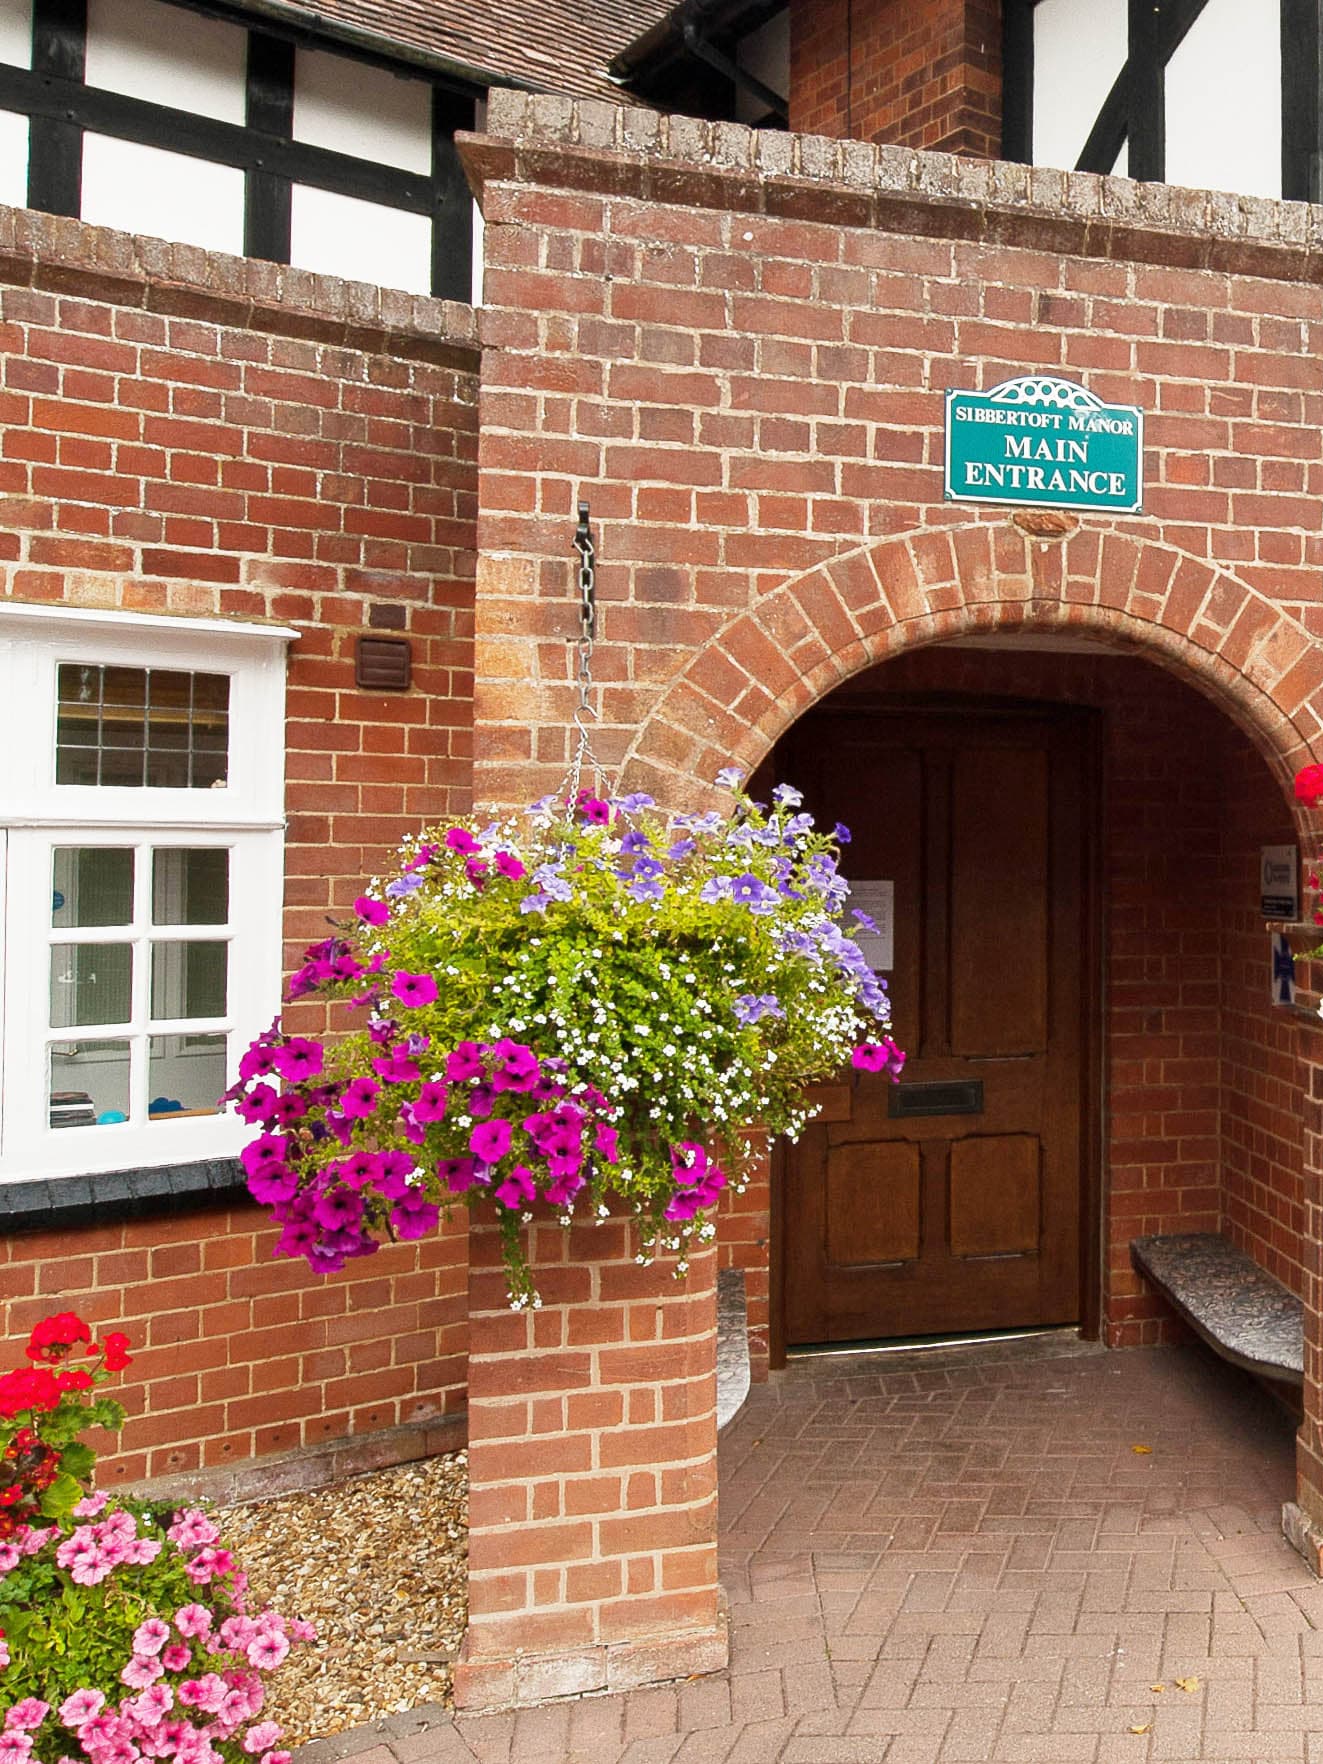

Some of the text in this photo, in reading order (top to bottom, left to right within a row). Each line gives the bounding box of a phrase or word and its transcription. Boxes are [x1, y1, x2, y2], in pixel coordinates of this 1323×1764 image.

[955, 407, 1133, 435] SIBBERTOFT MANOR
[1004, 435, 1088, 463] MAIN
[965, 462, 1126, 495] ENTRANCE
